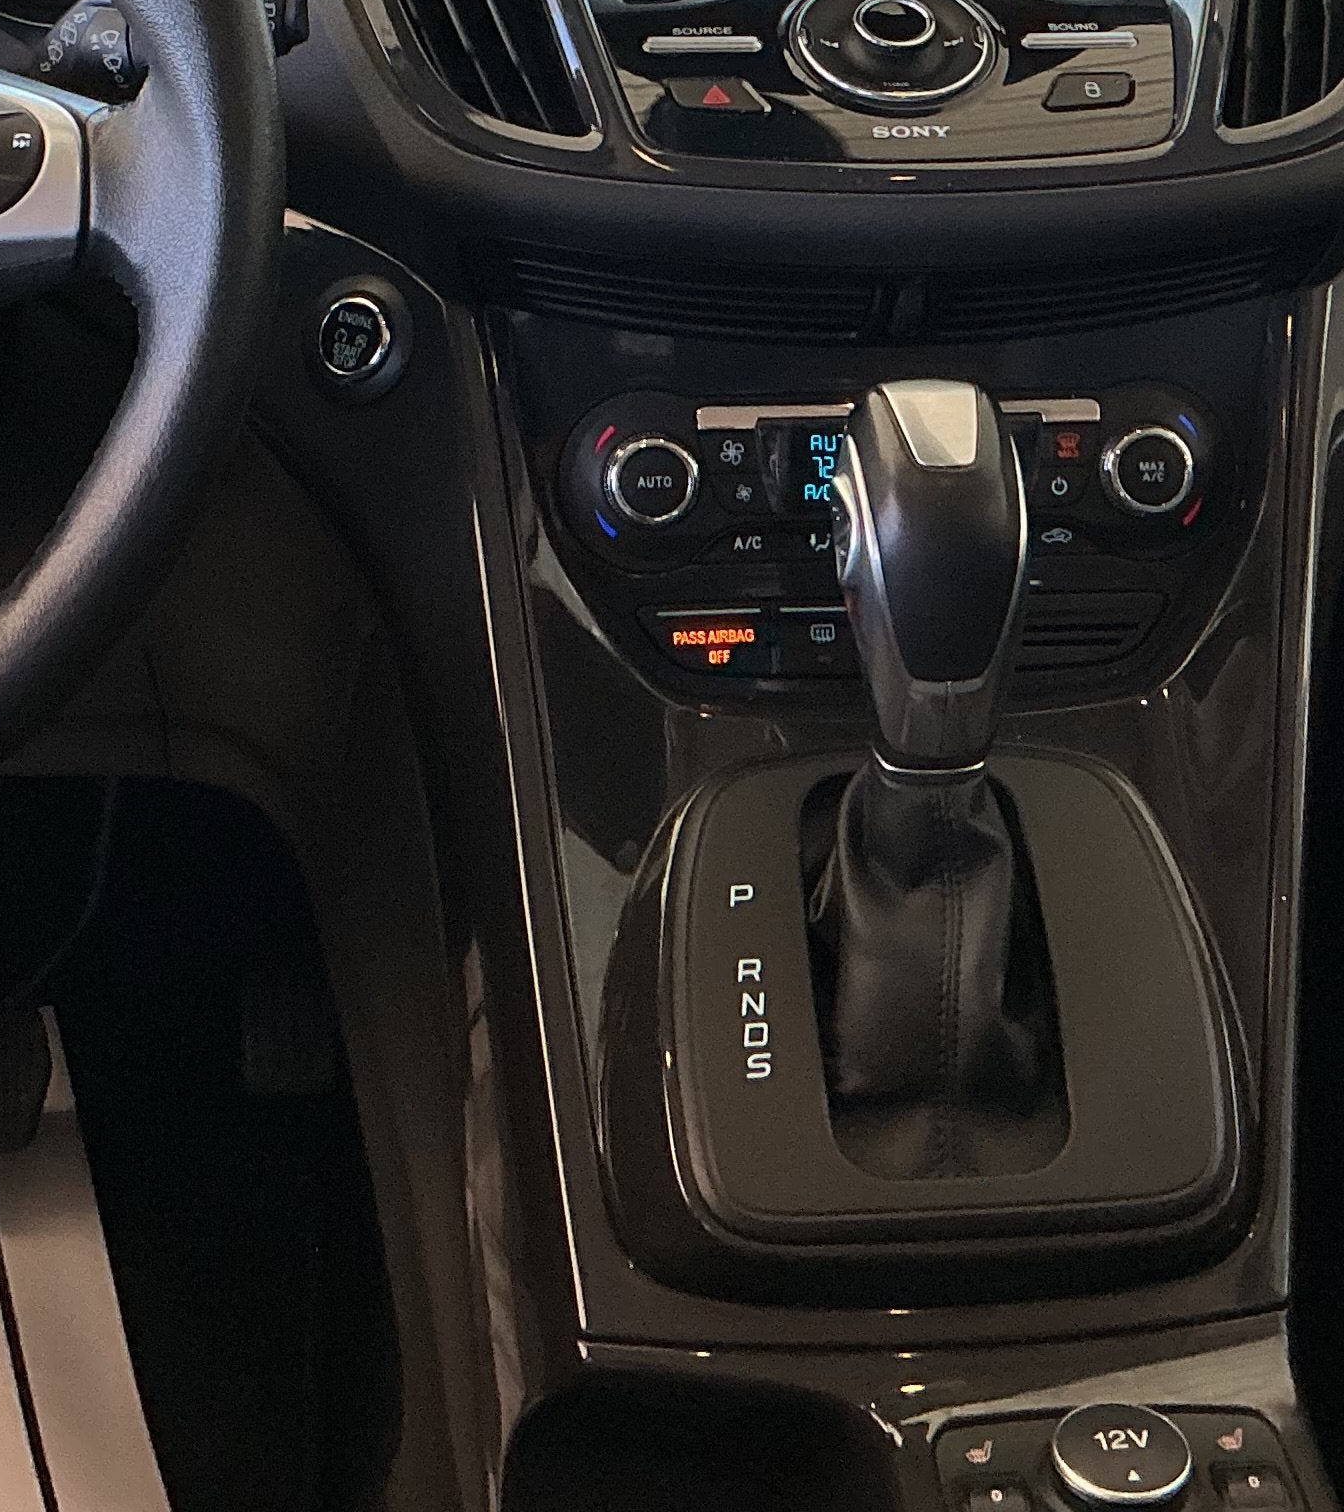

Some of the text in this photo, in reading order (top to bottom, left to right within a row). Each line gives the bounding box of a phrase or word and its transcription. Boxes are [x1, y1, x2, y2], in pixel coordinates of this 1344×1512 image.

[671, 25, 734, 38] SOURCE
[1047, 21, 1100, 33] SOUND
[871, 124, 952, 141] SONY
[1139, 461, 1165, 472] MAX
[636, 474, 673, 489] AUTO
[733, 535, 763, 552] A/C
[672, 627, 756, 647] PASS AIRBAG
[708, 649, 731, 665] OFF
[730, 884, 754, 908] P
[737, 958, 762, 983] R
[741, 991, 765, 1017] N
[744, 1022, 769, 1048] D
[746, 1052, 772, 1080] S
[1093, 1428, 1150, 1452] 12V
